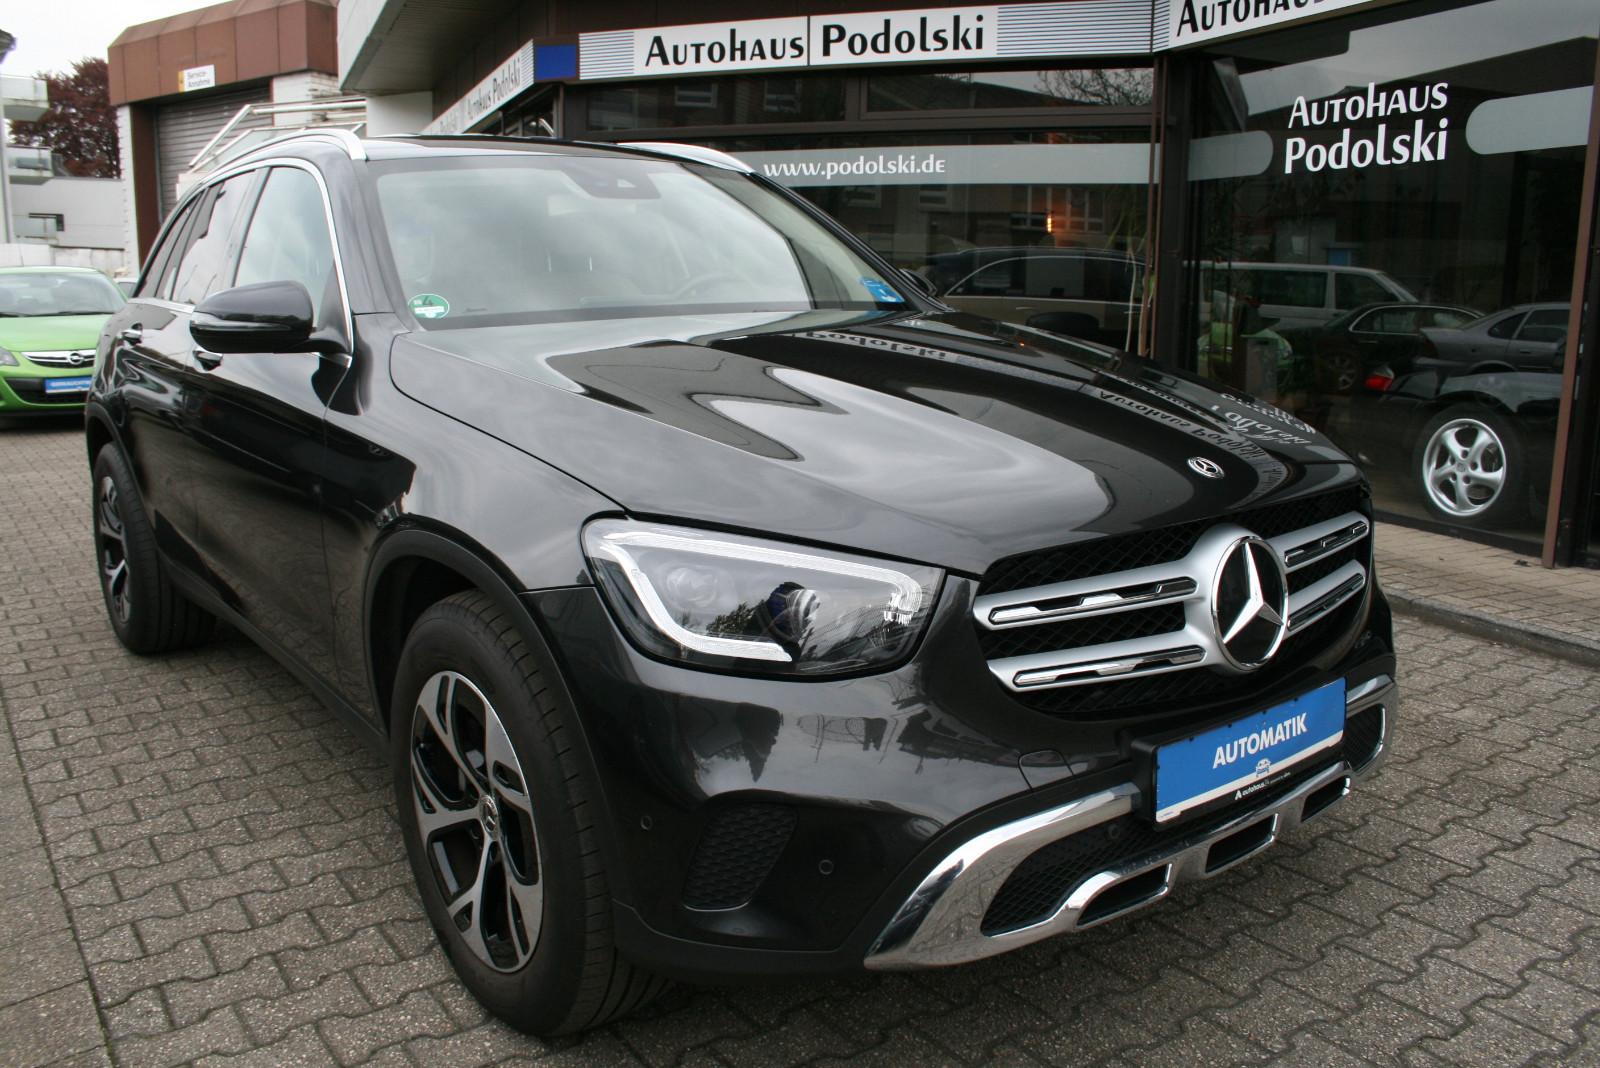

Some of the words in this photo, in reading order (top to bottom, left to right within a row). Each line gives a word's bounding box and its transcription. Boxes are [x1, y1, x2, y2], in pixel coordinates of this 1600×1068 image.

[821, 14, 984, 57] Podolski
[1284, 117, 1449, 174] Podolski
[1212, 712, 1308, 769] AUTOMATIK
